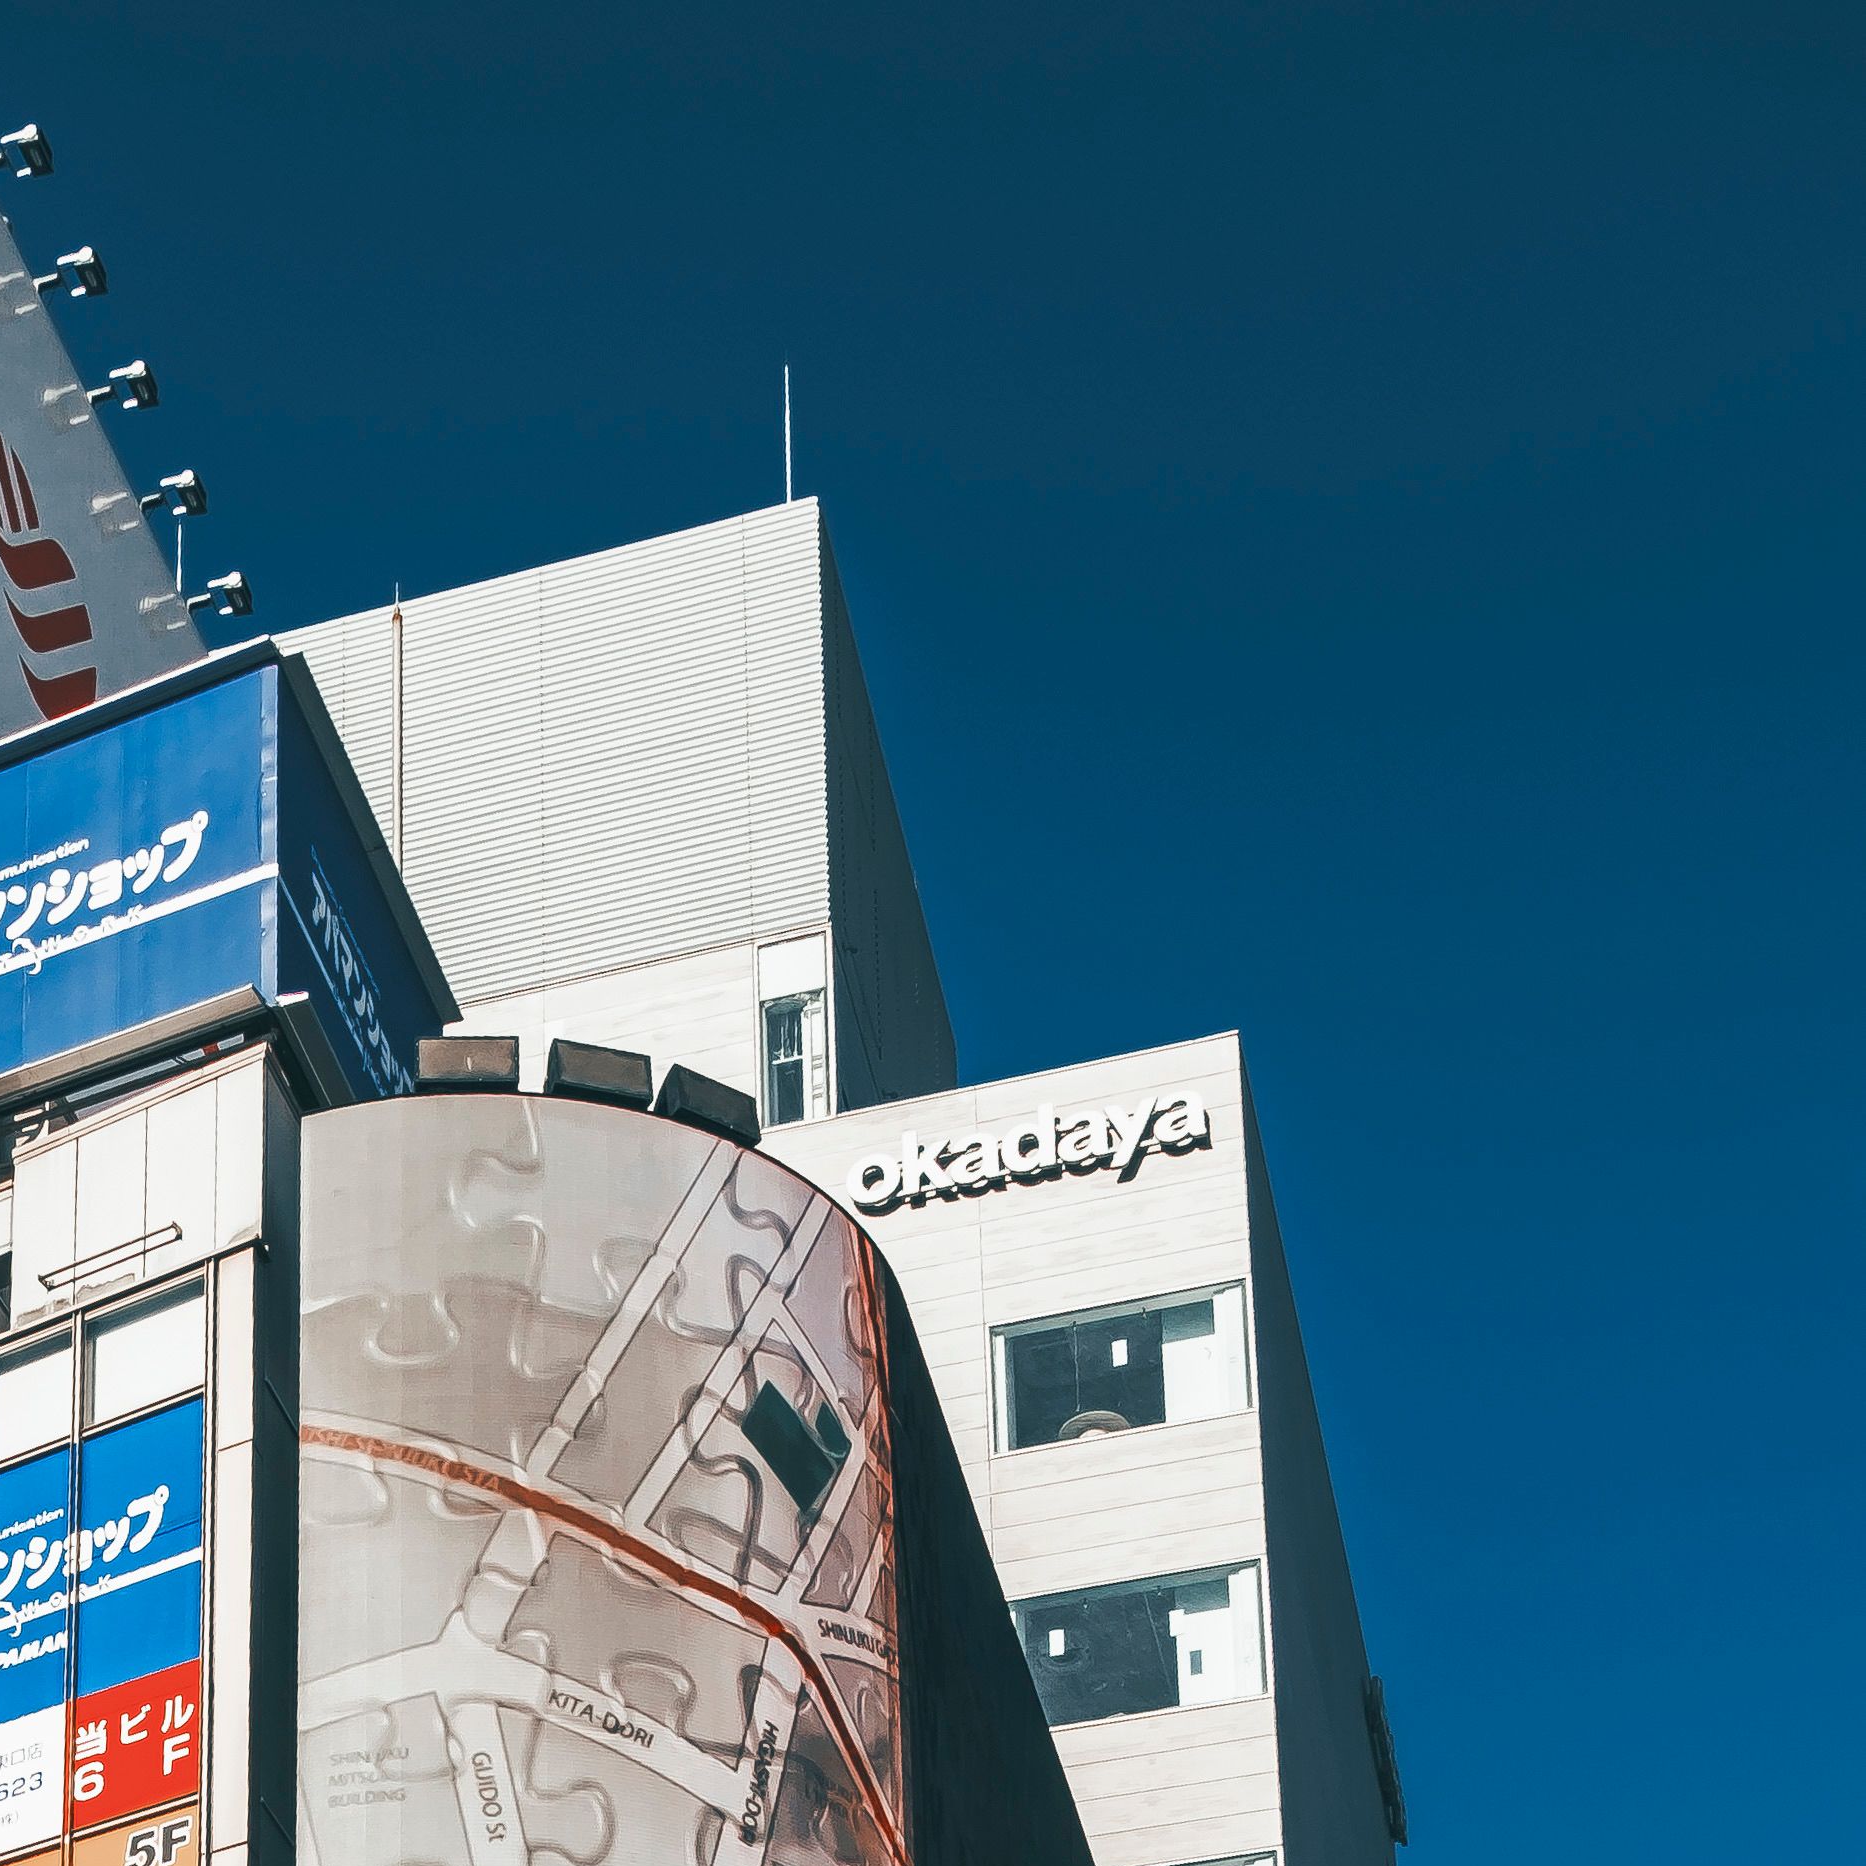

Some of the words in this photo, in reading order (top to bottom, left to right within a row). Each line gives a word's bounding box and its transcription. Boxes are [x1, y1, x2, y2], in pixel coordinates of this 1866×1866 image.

[845, 1089, 1208, 1206] okadaya
[75, 1695, 195, 1759] 当ビル
[548, 1688, 655, 1748] KITA-DORI
